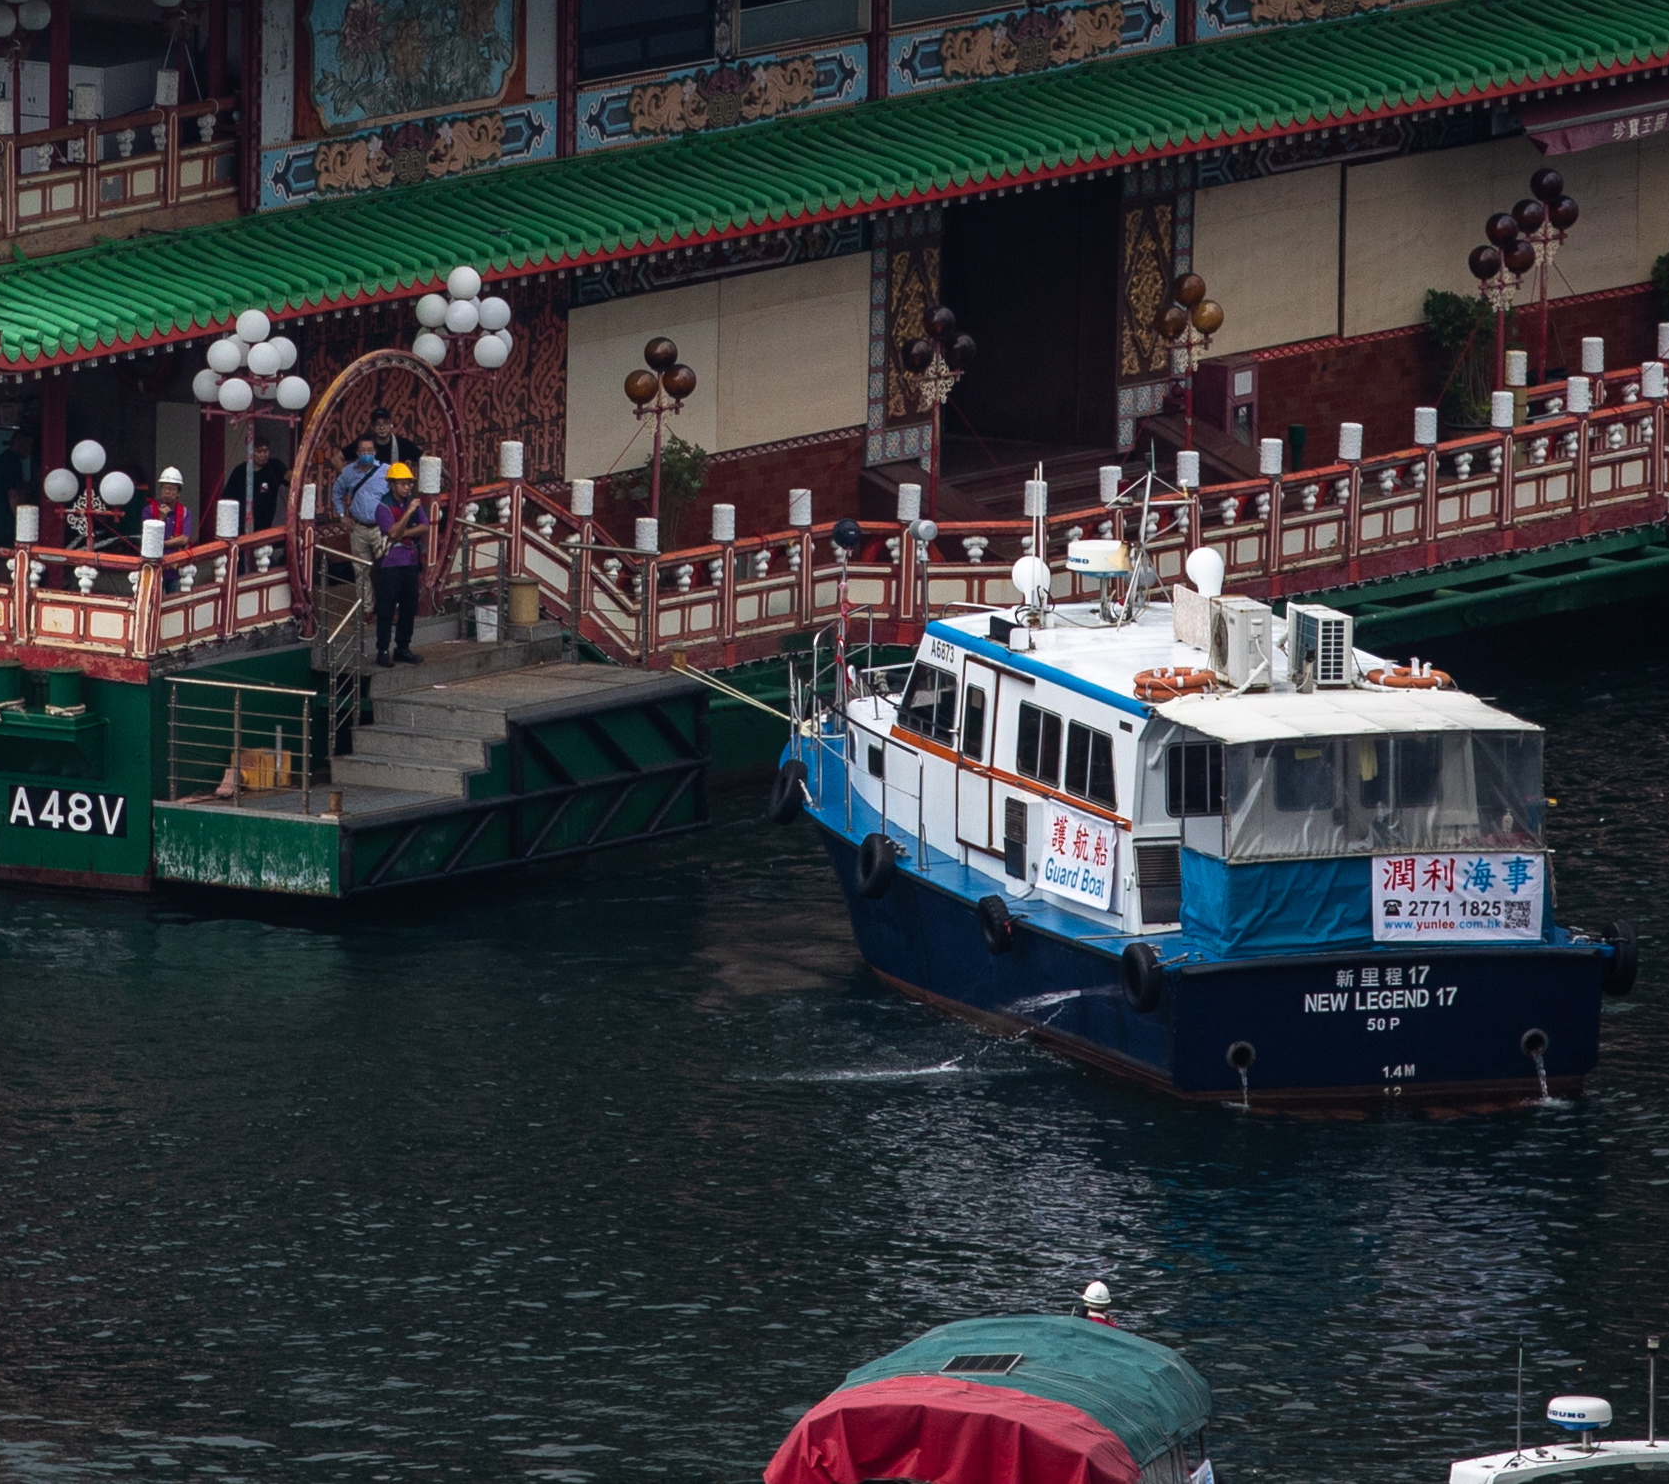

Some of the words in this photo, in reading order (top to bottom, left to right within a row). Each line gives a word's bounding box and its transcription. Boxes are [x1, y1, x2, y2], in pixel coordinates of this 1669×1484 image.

[1611, 111, 1667, 140] 珍寶王國
[930, 639, 956, 664] A6873
[10, 786, 124, 835] A48V
[1050, 815, 1110, 868] 護航船
[1044, 857, 1079, 890] Guard
[1079, 868, 1106, 900] Boat
[1379, 857, 1530, 895] 潤利海事
[1404, 901, 1447, 918] 2771
[1455, 899, 1497, 917] 1825
[1379, 919, 1497, 933] www.yunlee.com.hk
[1336, 969, 1403, 989] 新里程
[1408, 965, 1431, 985] 17
[1304, 992, 1348, 1013] NEW
[1355, 988, 1429, 1011] LEGEND
[1435, 987, 1458, 1007] 17
[1367, 1017, 1386, 1031] 50
[1390, 1017, 1400, 1031] P
